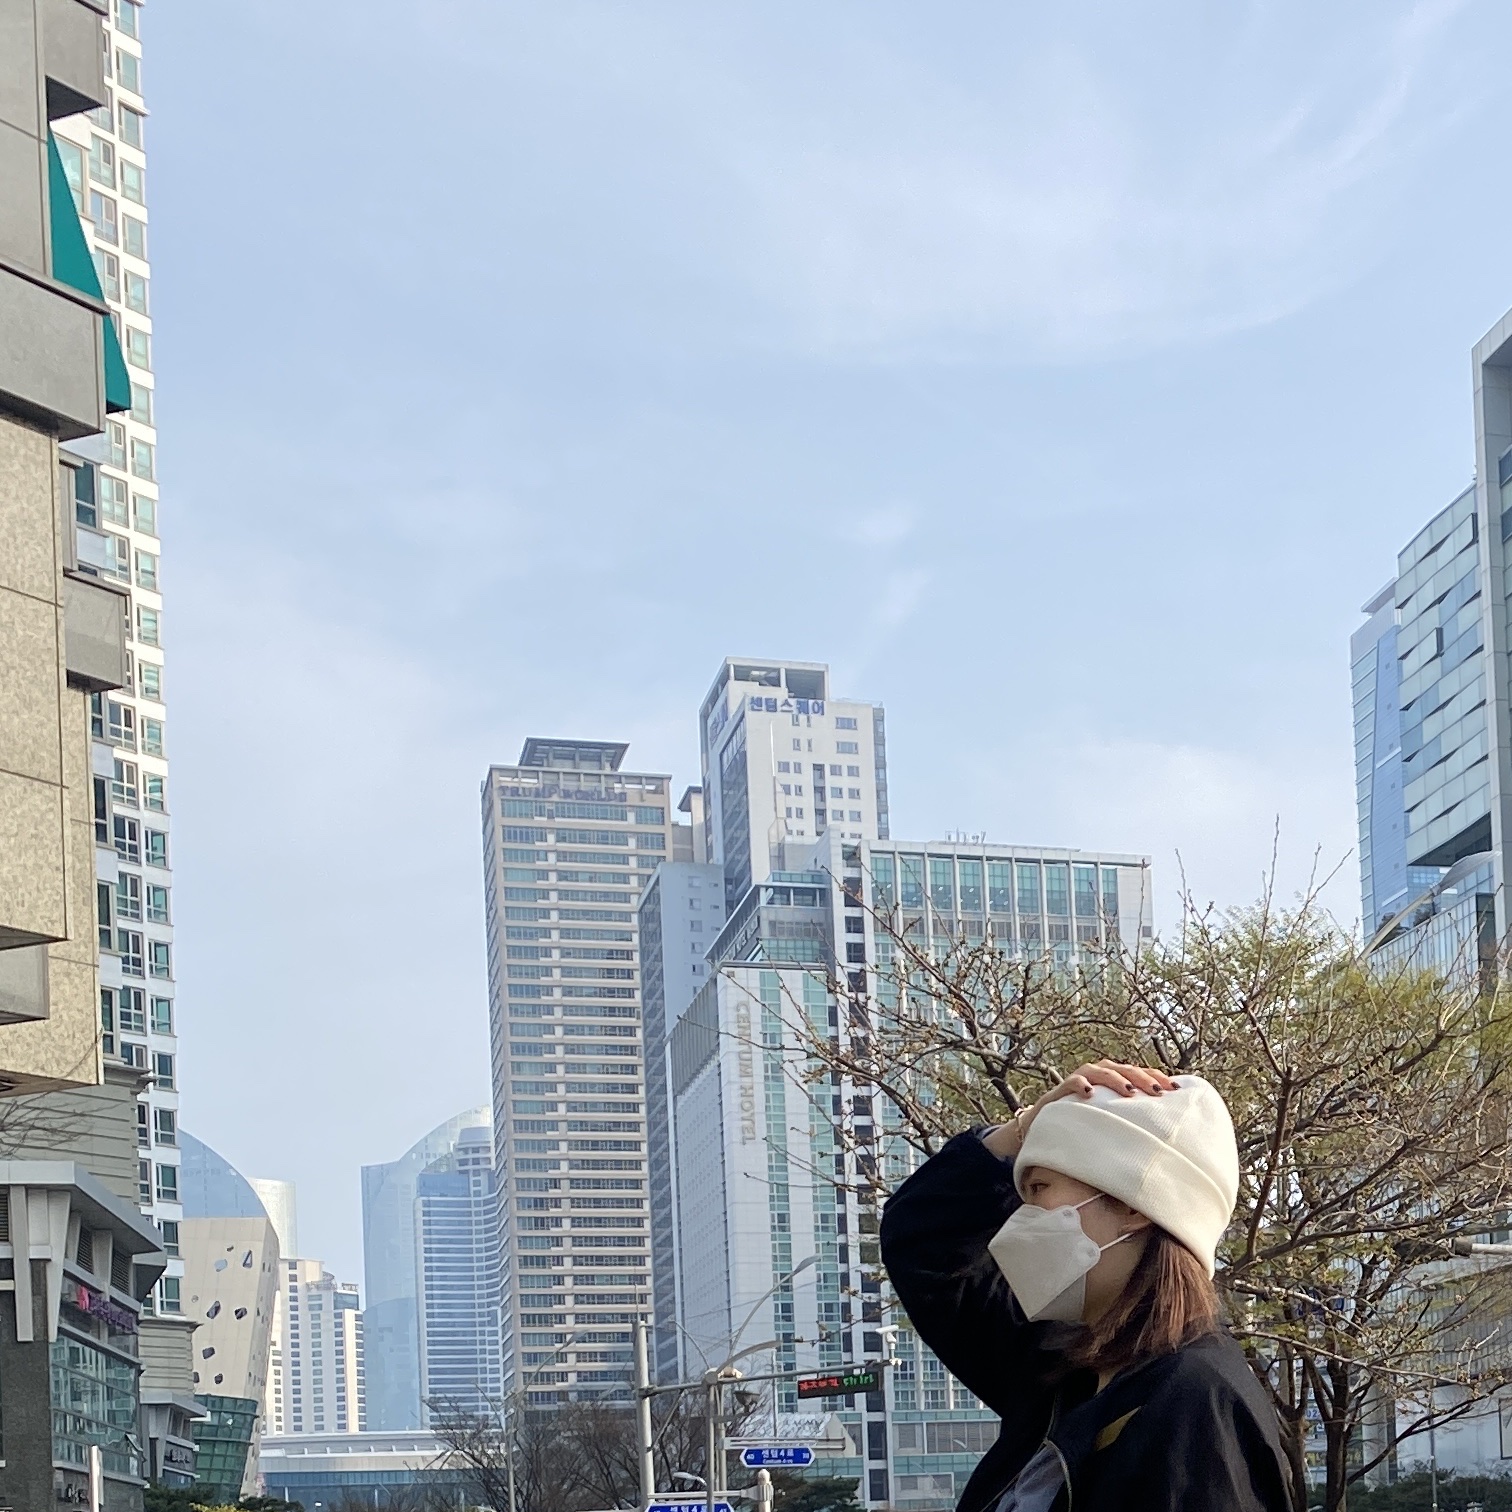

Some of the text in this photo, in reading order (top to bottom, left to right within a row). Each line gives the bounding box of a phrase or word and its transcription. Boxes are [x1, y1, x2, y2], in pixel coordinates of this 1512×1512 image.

[749, 696, 825, 716] 센텀스퀘어
[736, 1002, 757, 1145] CENTUM HOTEL
[762, 1448, 795, 1458] 센텀4로
